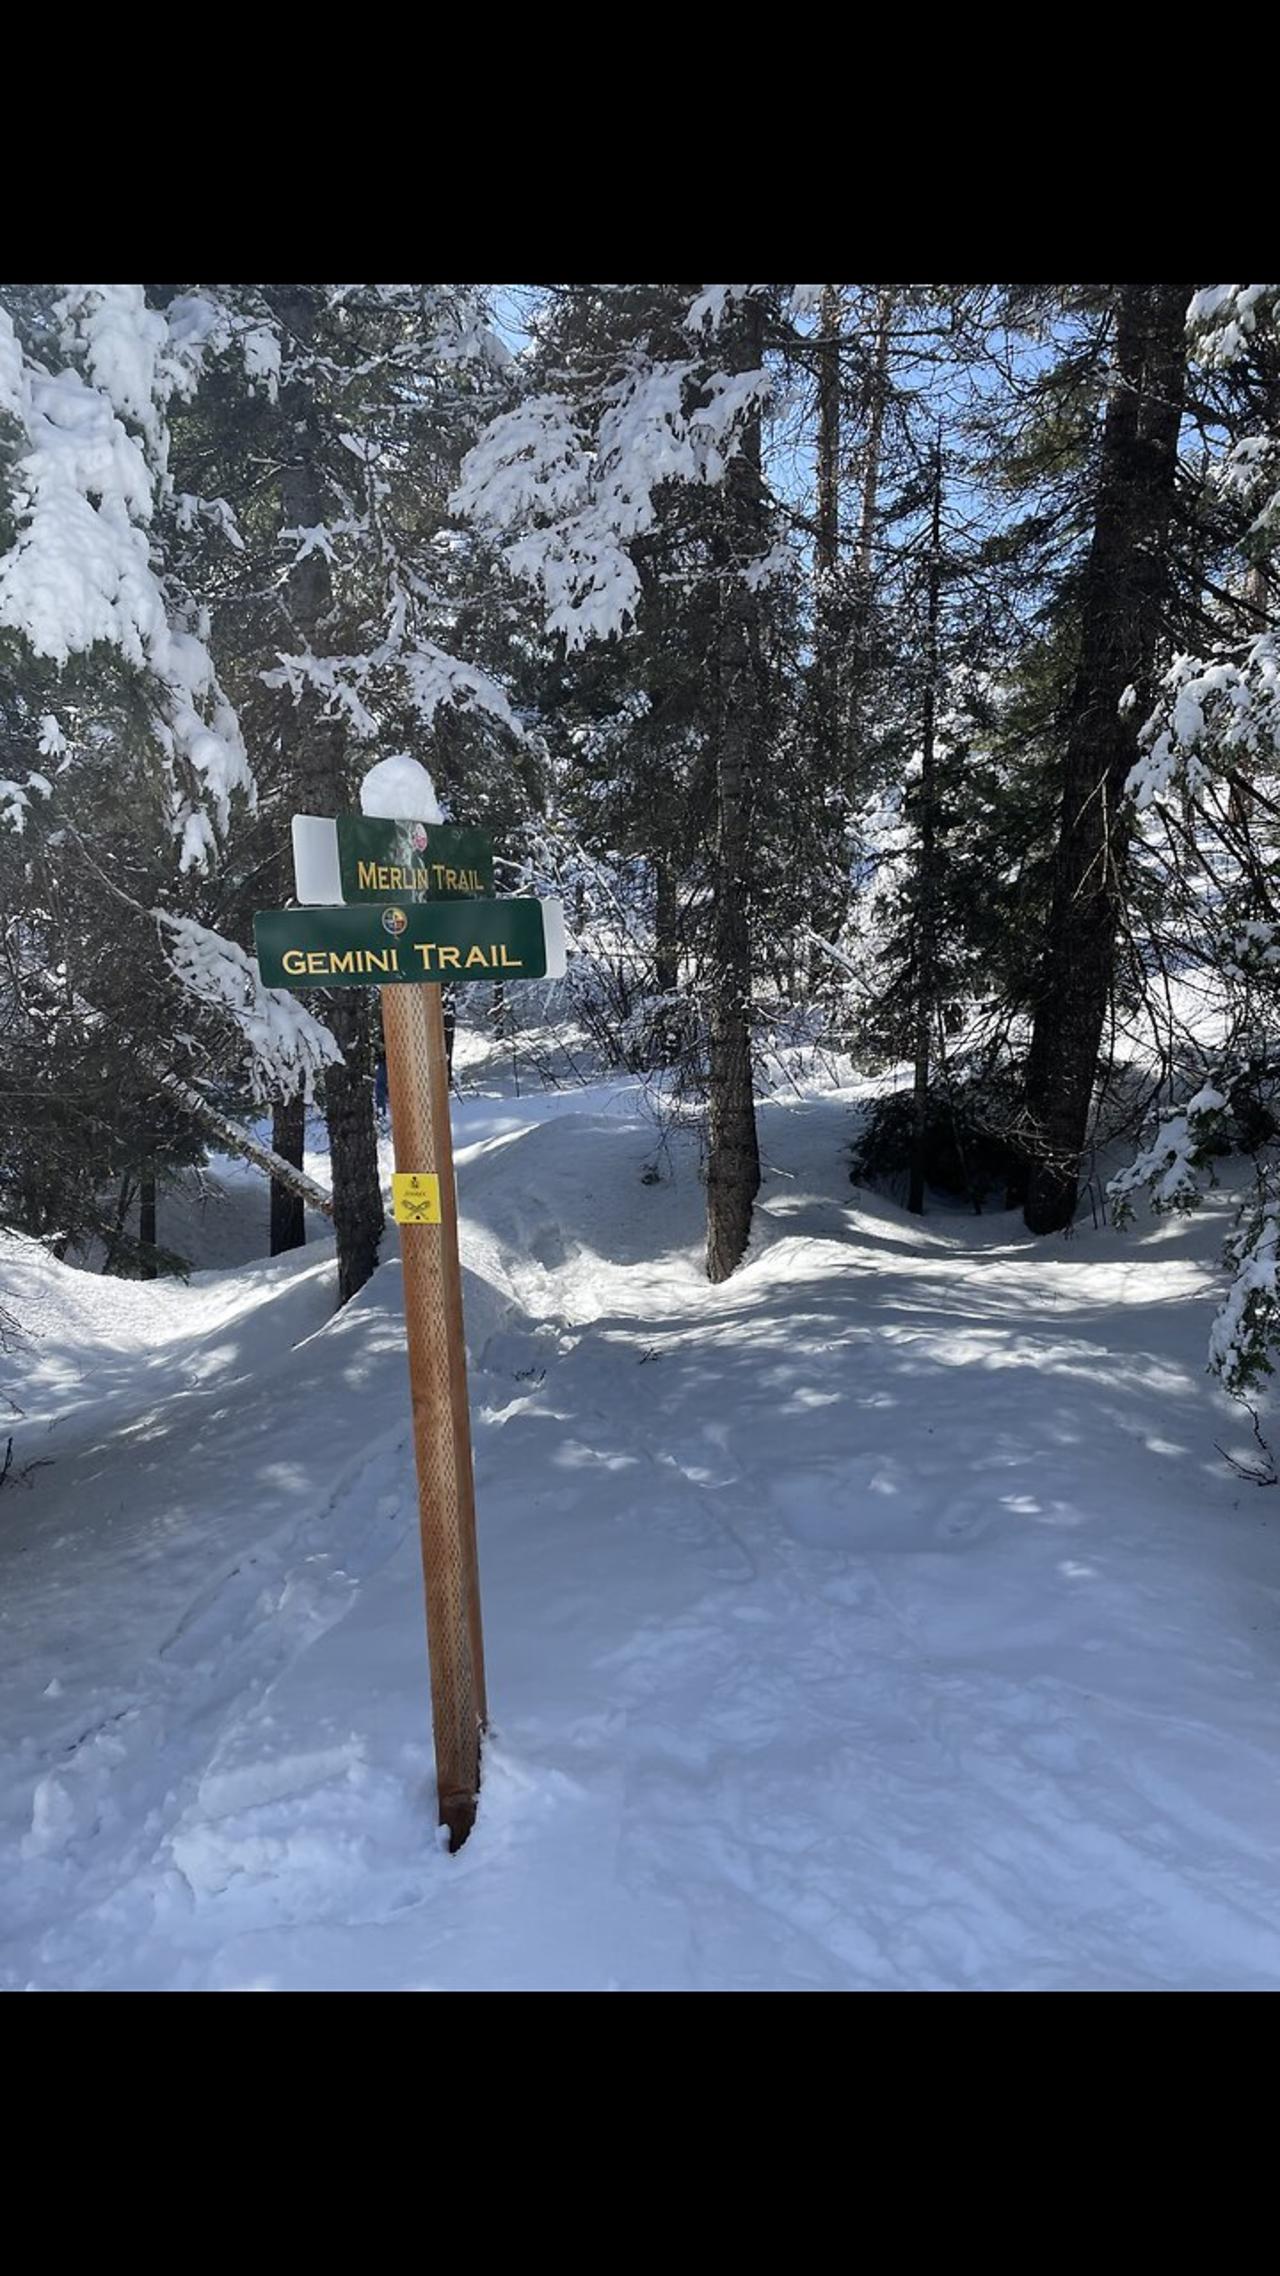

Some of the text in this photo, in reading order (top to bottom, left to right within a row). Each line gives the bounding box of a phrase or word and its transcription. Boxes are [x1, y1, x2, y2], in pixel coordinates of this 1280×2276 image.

[357, 861, 484, 890] MERLIN TRAIL
[281, 943, 522, 975] GEMINI TRAIL
